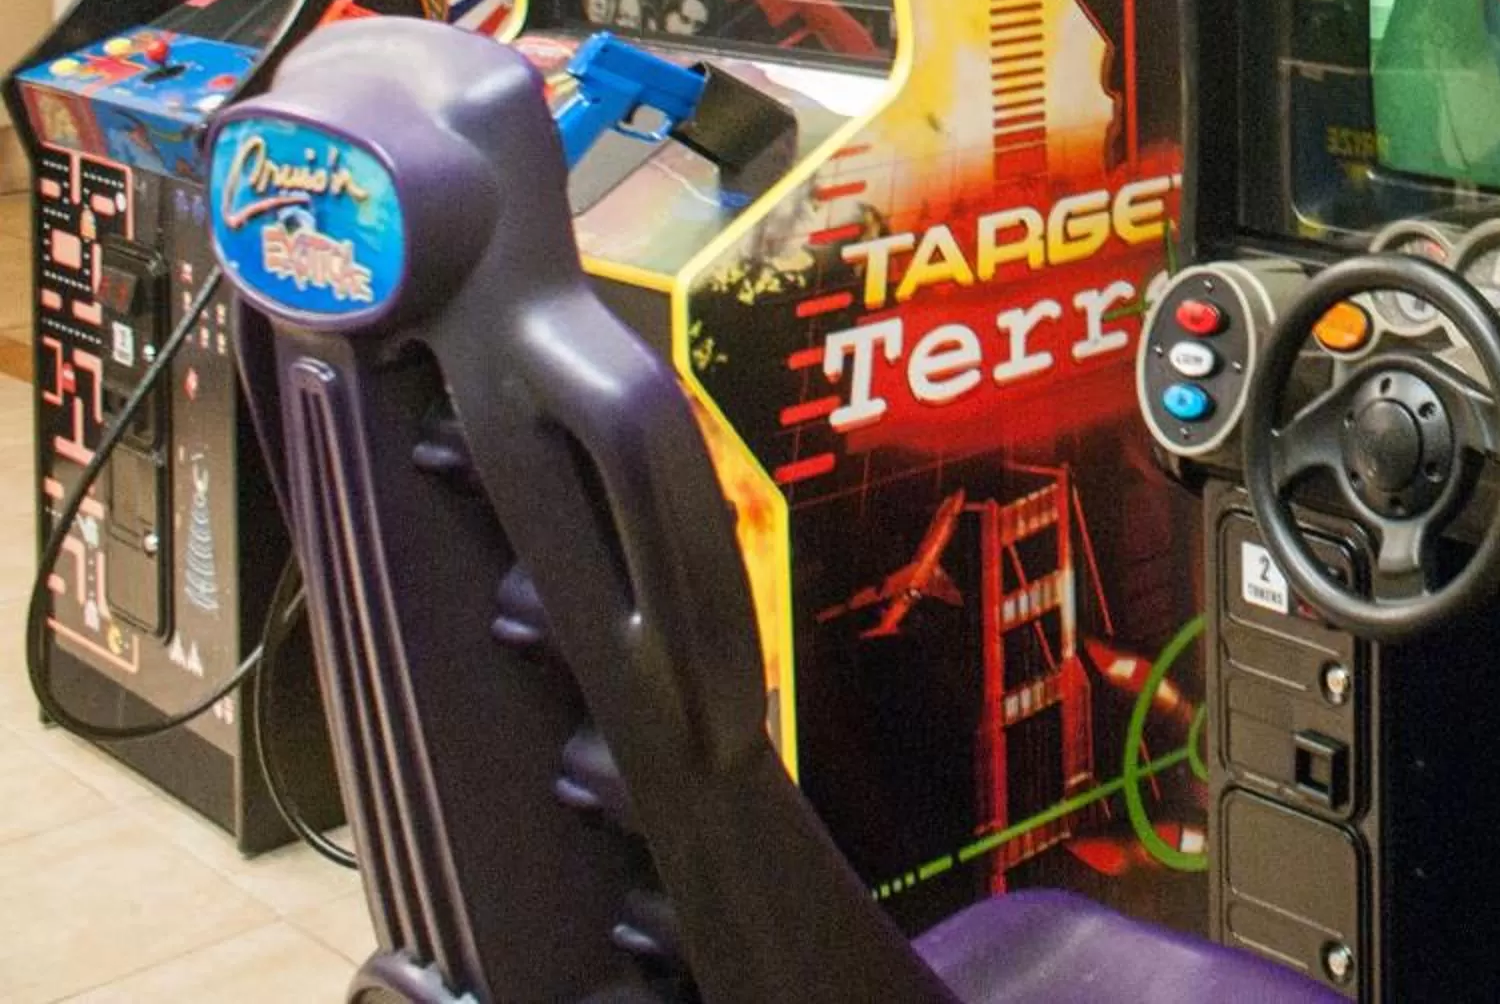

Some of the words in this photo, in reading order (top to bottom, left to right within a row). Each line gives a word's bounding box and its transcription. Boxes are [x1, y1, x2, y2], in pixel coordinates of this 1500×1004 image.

[223, 135, 371, 229] Cruis'n
[841, 174, 1182, 309] TARGE
[822, 270, 1168, 433] Terr
[1258, 555, 1271, 583] 2
